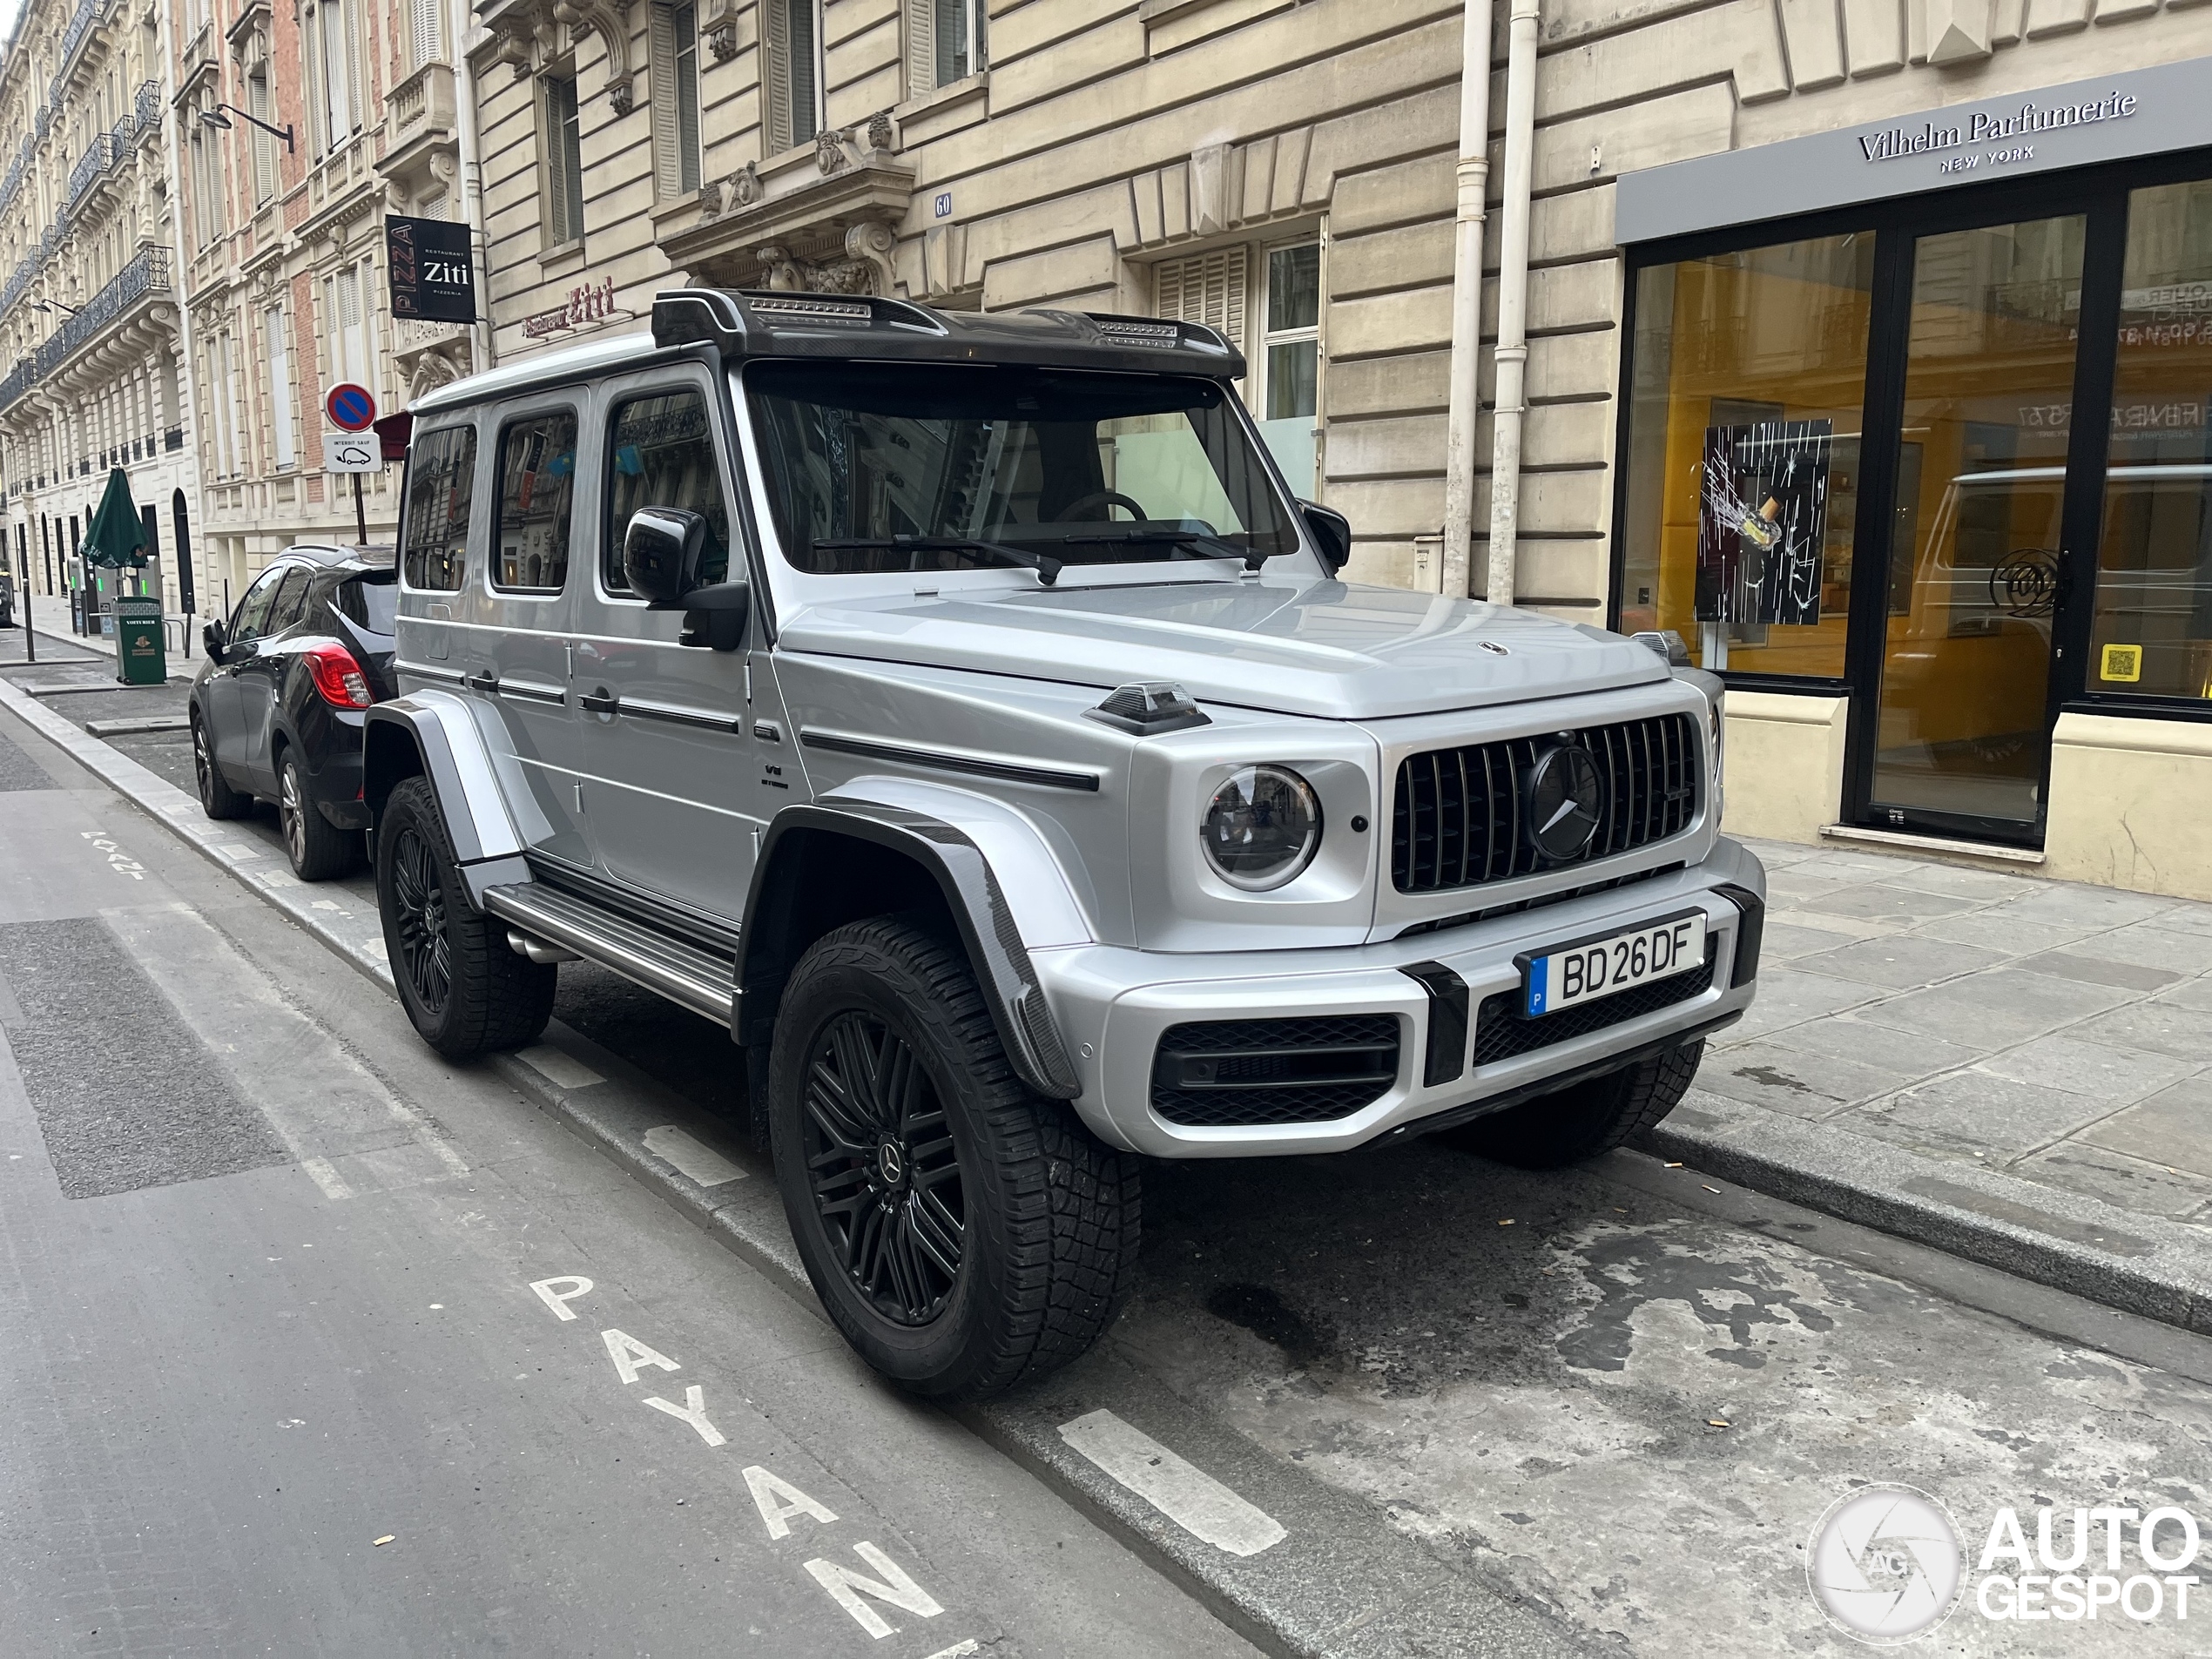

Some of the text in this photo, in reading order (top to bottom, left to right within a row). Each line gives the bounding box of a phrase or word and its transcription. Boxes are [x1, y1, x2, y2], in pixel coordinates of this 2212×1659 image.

[1857, 90, 2138, 163] Vilhelm Parfumerie
[1940, 145, 2036, 174] NEW YORK
[936, 195, 950, 215] 60
[425, 248, 465, 258] RESTAURANT
[391, 224, 418, 314] PIZZA
[423, 261, 469, 286] Ziti
[432, 288, 462, 297] PIZZERIA
[765, 764, 782, 776] V8
[80, 831, 148, 880] PAYANT
[1562, 921, 1692, 1001] BD 26 DF
[1534, 993, 1541, 1007] P
[529, 1275, 978, 1659] PAYAN
